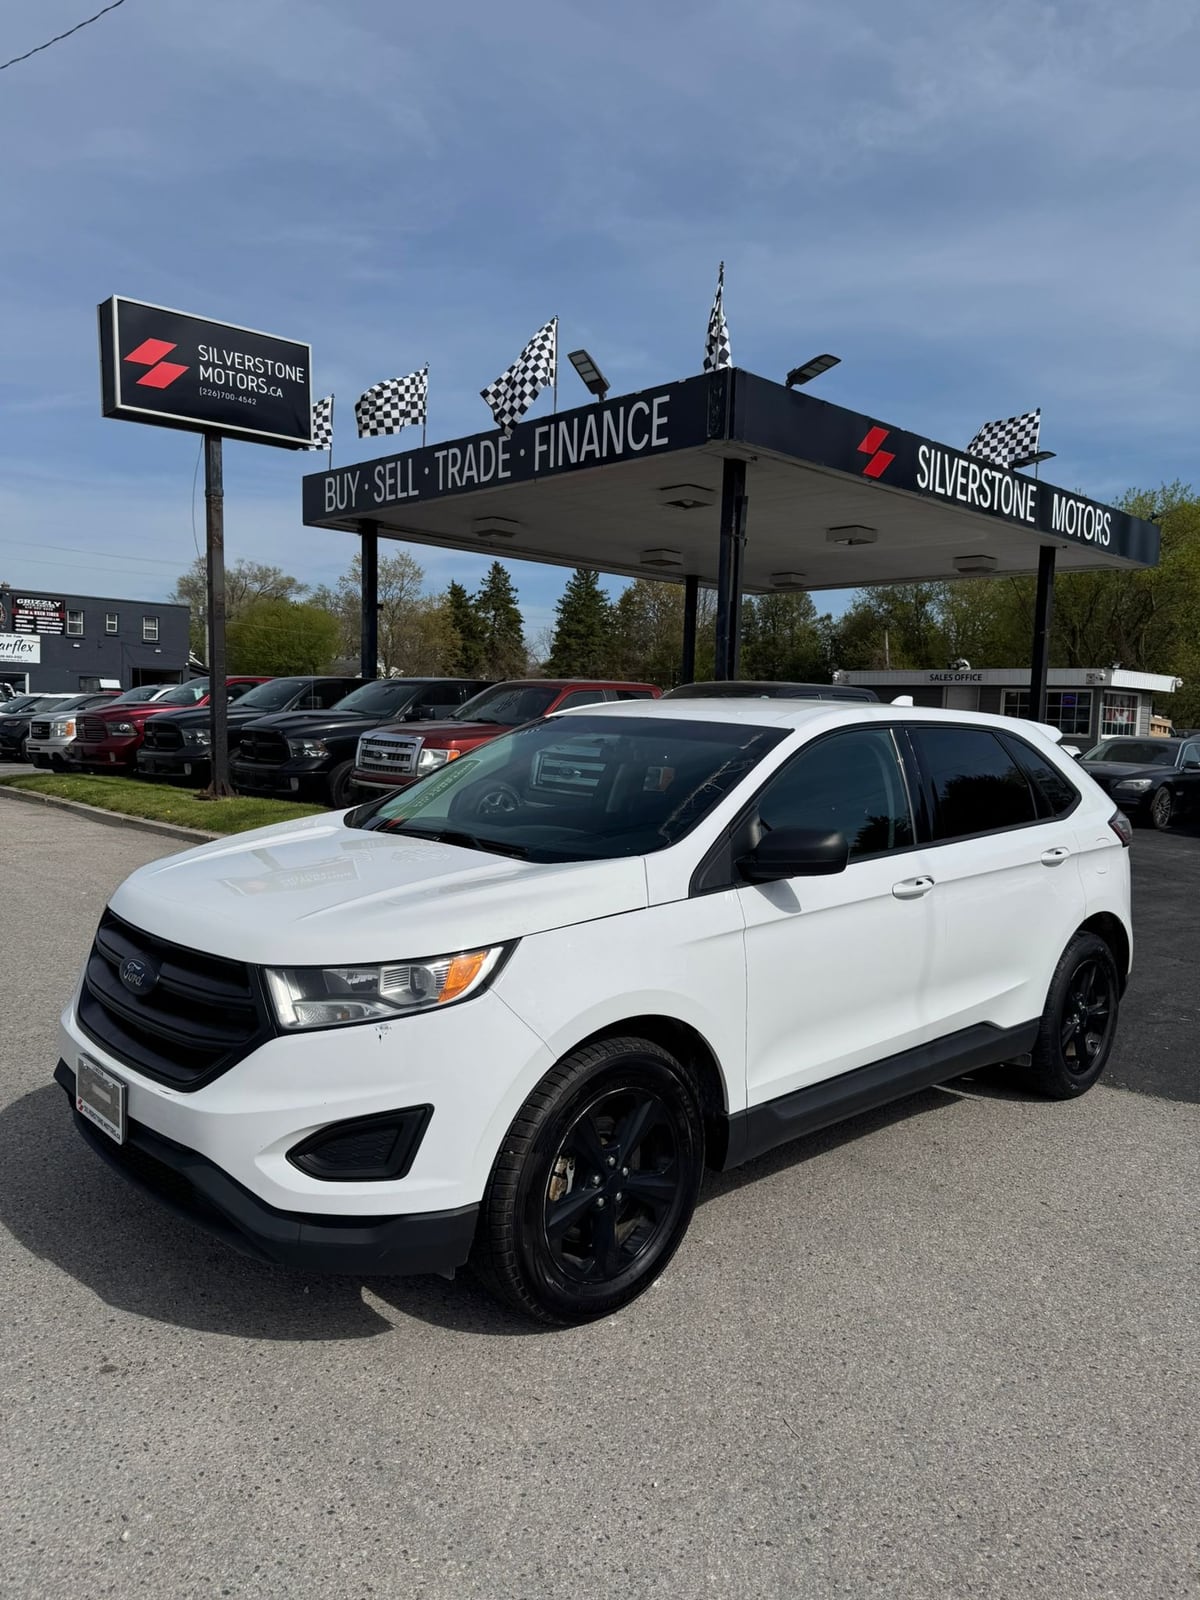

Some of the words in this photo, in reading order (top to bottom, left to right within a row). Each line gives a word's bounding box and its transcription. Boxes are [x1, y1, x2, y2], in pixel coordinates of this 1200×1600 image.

[198, 344, 305, 384] SILVERSTONE
[200, 364, 283, 398] MOTORS.CA
[200, 386, 257, 406] (226)700-4542
[325, 470, 360, 513] BUY
[373, 459, 419, 504] SELL
[434, 435, 511, 491] TRADE
[534, 394, 671, 472] FINANCE
[916, 445, 1037, 523] SILVERSTONE
[1051, 493, 1112, 547] MOTORS
[16, 598, 61, 607] GRIZZLY
[929, 673, 953, 682] SALES
[954, 673, 983, 682] OFFICE
[123, 961, 145, 987] Ford
